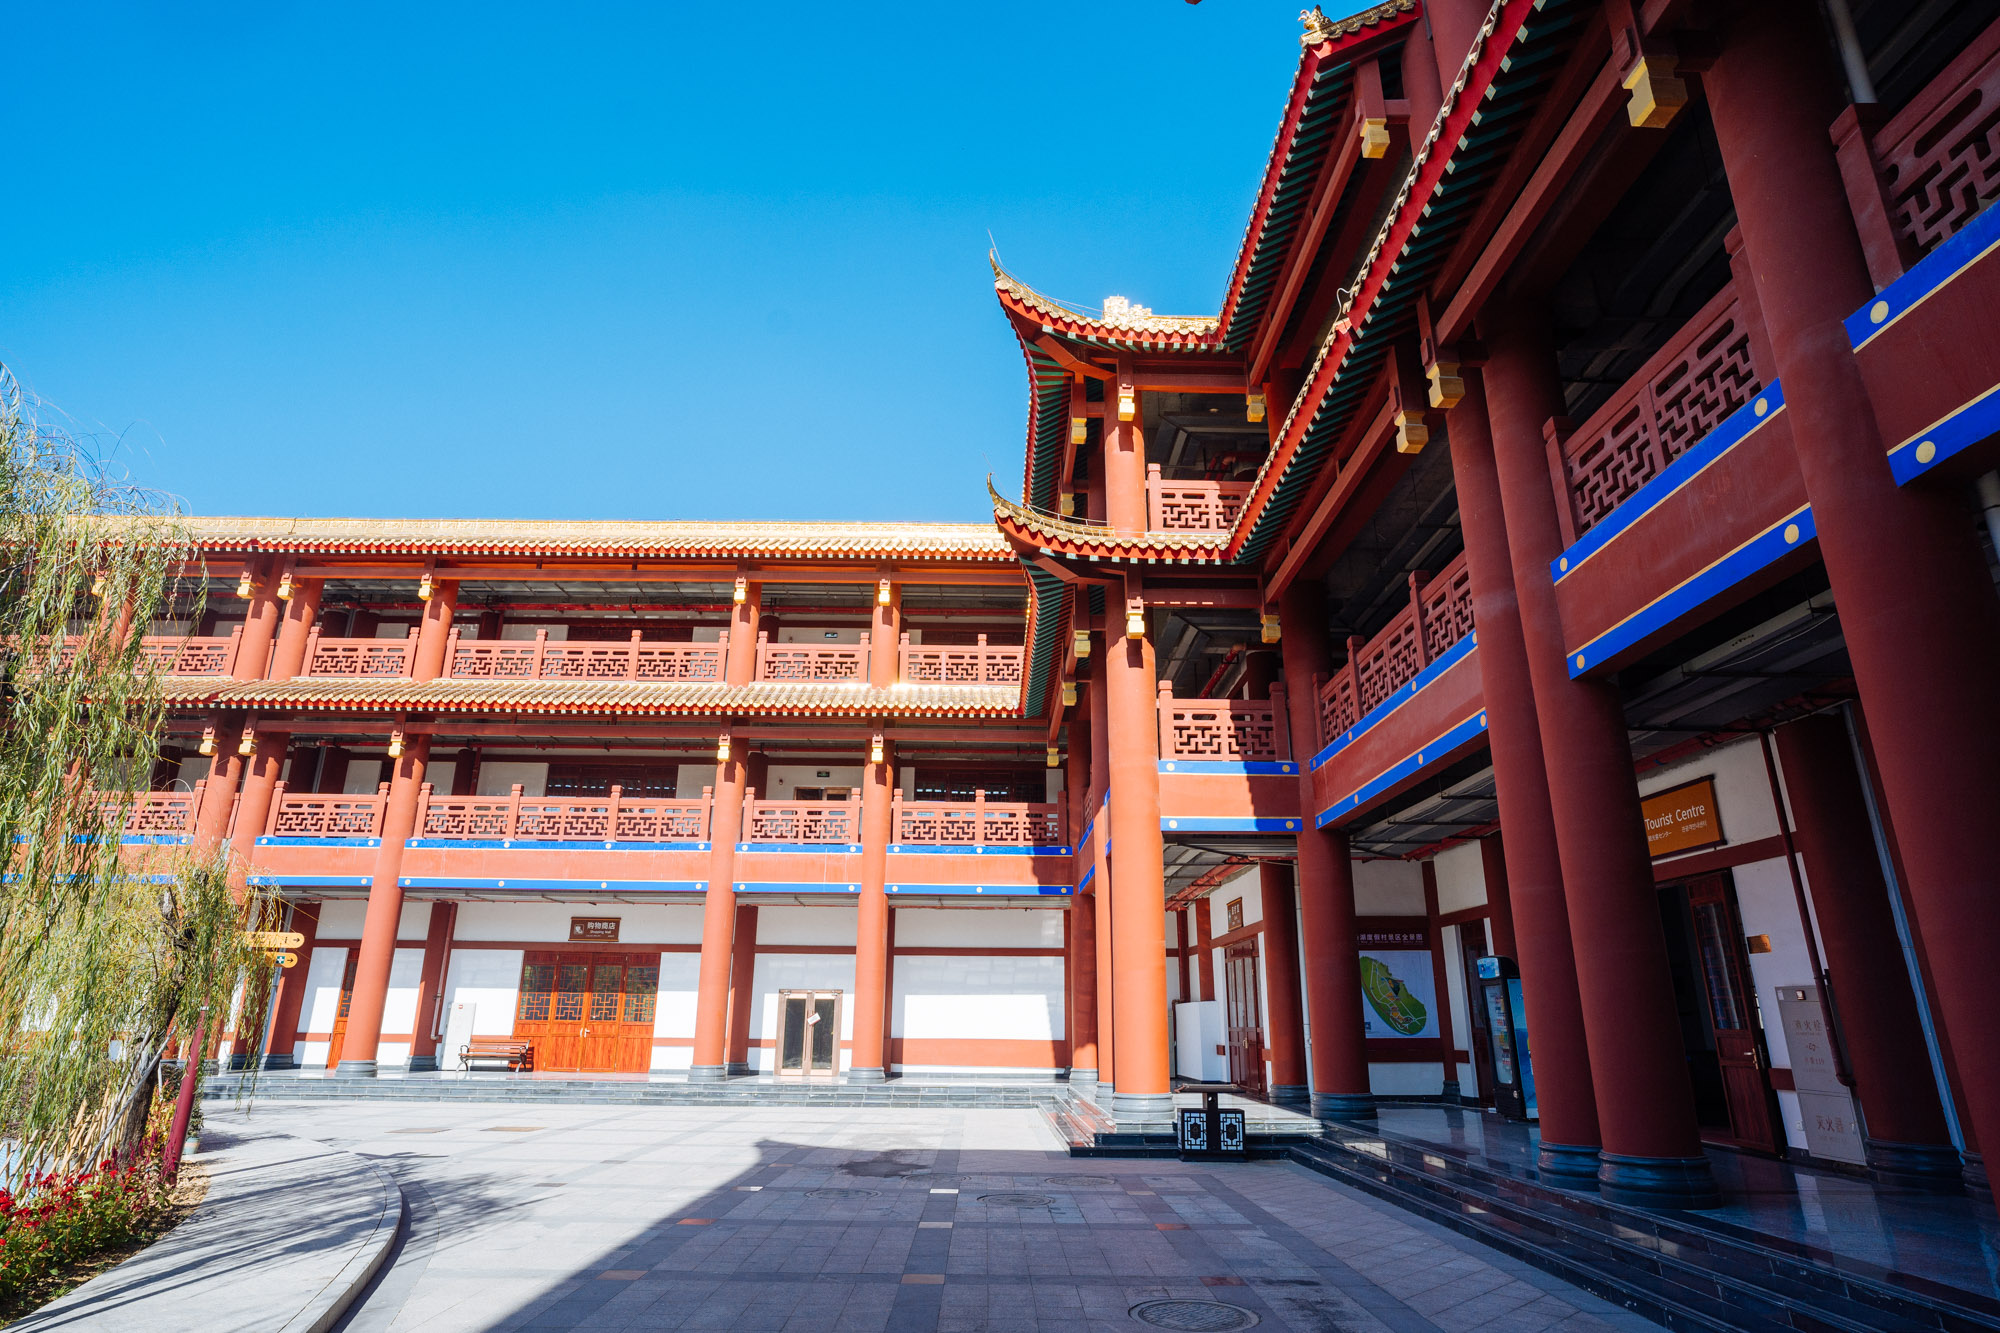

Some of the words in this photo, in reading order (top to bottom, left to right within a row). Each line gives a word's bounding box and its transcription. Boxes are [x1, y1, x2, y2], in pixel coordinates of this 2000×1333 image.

[1644, 812, 1674, 831] Tourist
[1675, 804, 1706, 822] Centre
[587, 921, 616, 930] 购物商店
[1816, 1114, 1844, 1133] 灭火器
